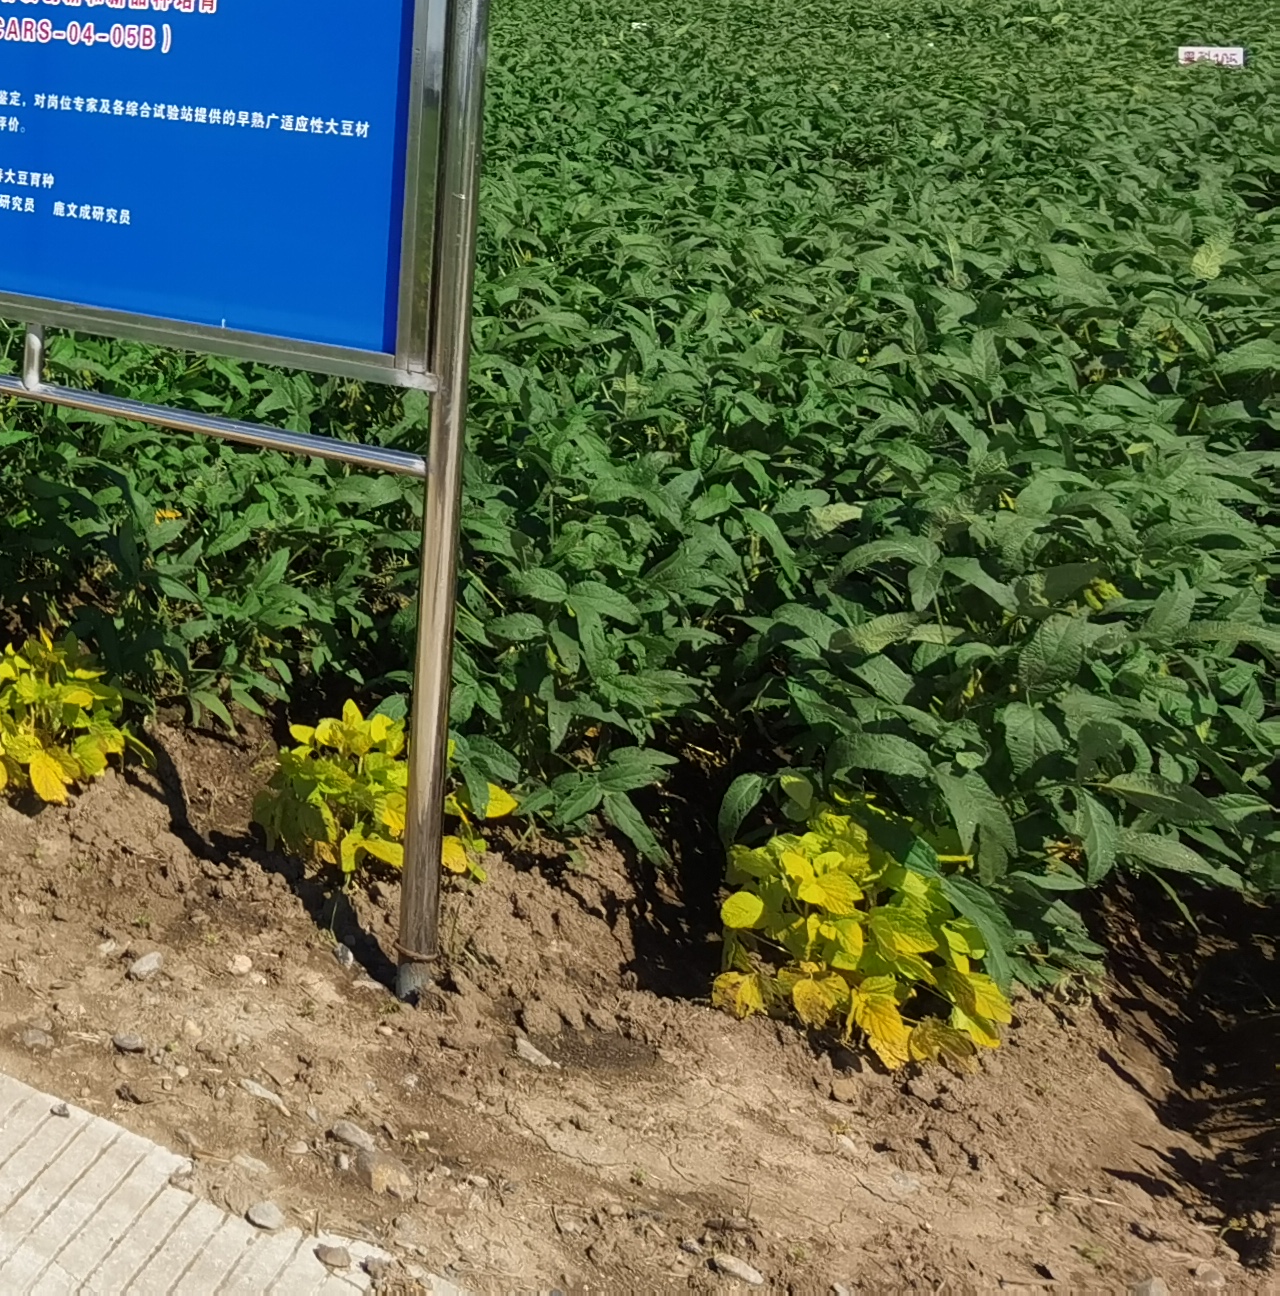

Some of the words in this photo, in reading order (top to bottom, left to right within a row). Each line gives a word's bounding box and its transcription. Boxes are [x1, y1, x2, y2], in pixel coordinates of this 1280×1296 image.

[52, 201, 131, 225] 鹿文成研究员
